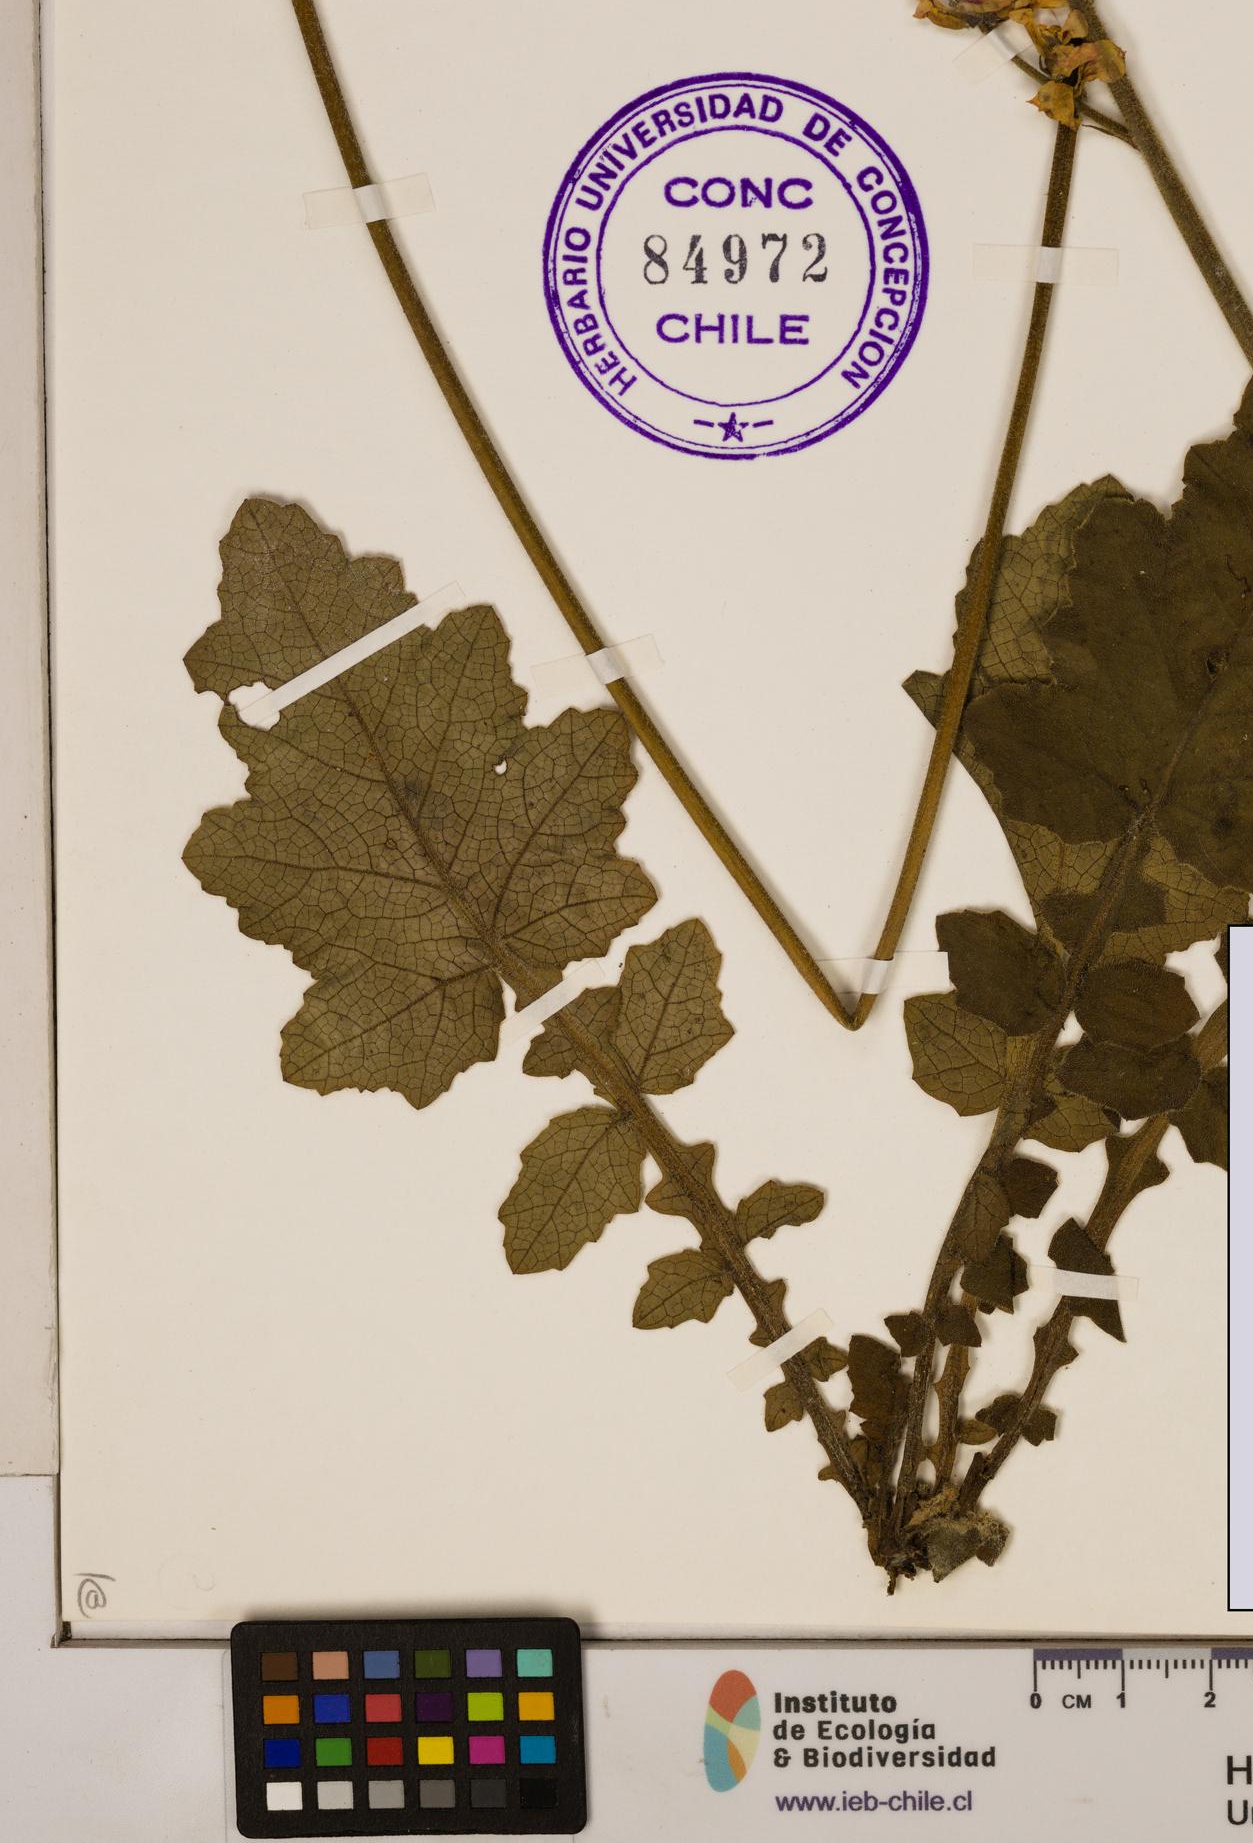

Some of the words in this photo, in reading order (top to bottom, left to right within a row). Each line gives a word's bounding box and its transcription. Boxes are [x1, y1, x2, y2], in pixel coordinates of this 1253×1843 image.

[802, 113, 853, 157] DE
[575, 93, 784, 212] UNIVERSIDAD
[663, 176, 814, 210] CONC
[643, 232, 829, 285] 84972
[841, 165, 909, 390] CONCEPCION
[562, 226, 638, 397] HERBARIO
[655, 313, 811, 346] CHILE
[774, 1690, 898, 1714] Instituto
[1029, 1693, 1043, 1710] 0
[1061, 1693, 1092, 1710] CM
[1116, 1692, 1126, 1709] 1
[1203, 1691, 1217, 1709] 2
[772, 1719, 806, 1741] de
[817, 1718, 937, 1745] Ecología
[773, 1747, 792, 1769] &
[803, 1745, 996, 1769] Biodiversidad
[774, 1789, 973, 1812] www.ieb-chile.cl
